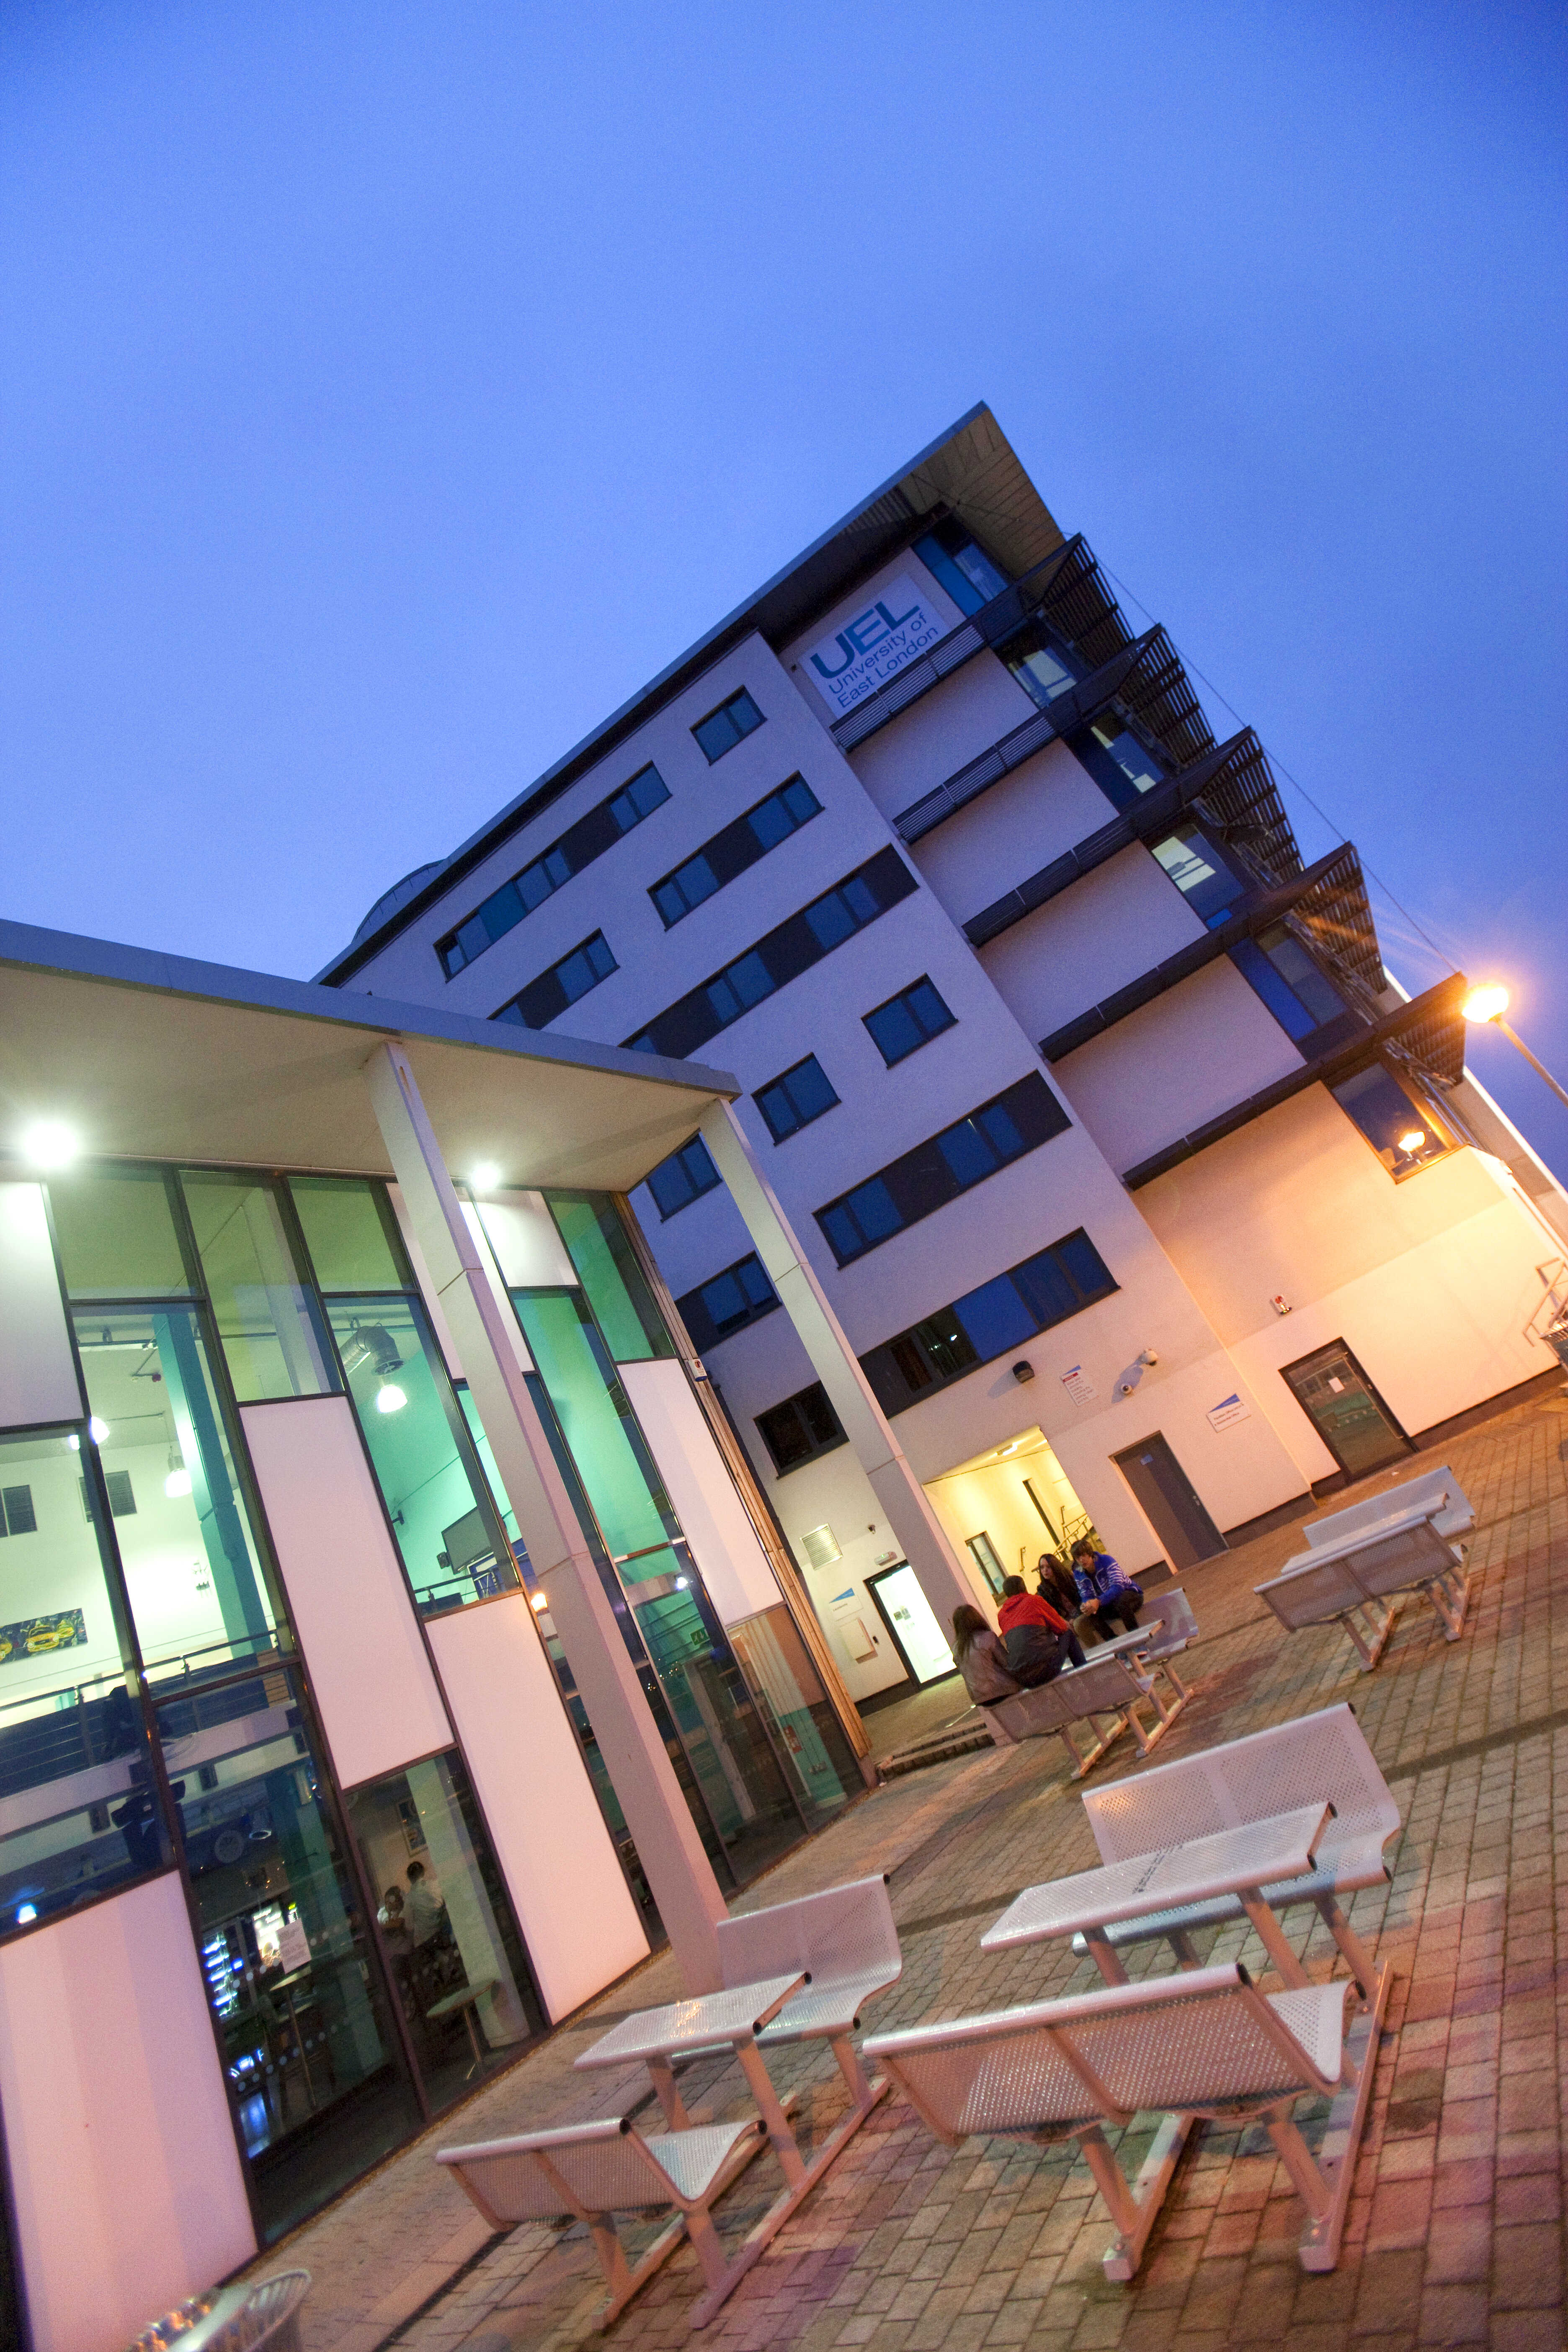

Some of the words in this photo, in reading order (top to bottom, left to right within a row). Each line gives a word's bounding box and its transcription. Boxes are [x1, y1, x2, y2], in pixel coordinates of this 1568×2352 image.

[810, 601, 921, 679] UEL
[828, 630, 906, 694] University
[910, 612, 927, 631] of
[837, 676, 875, 708] East
[874, 627, 939, 679] London
